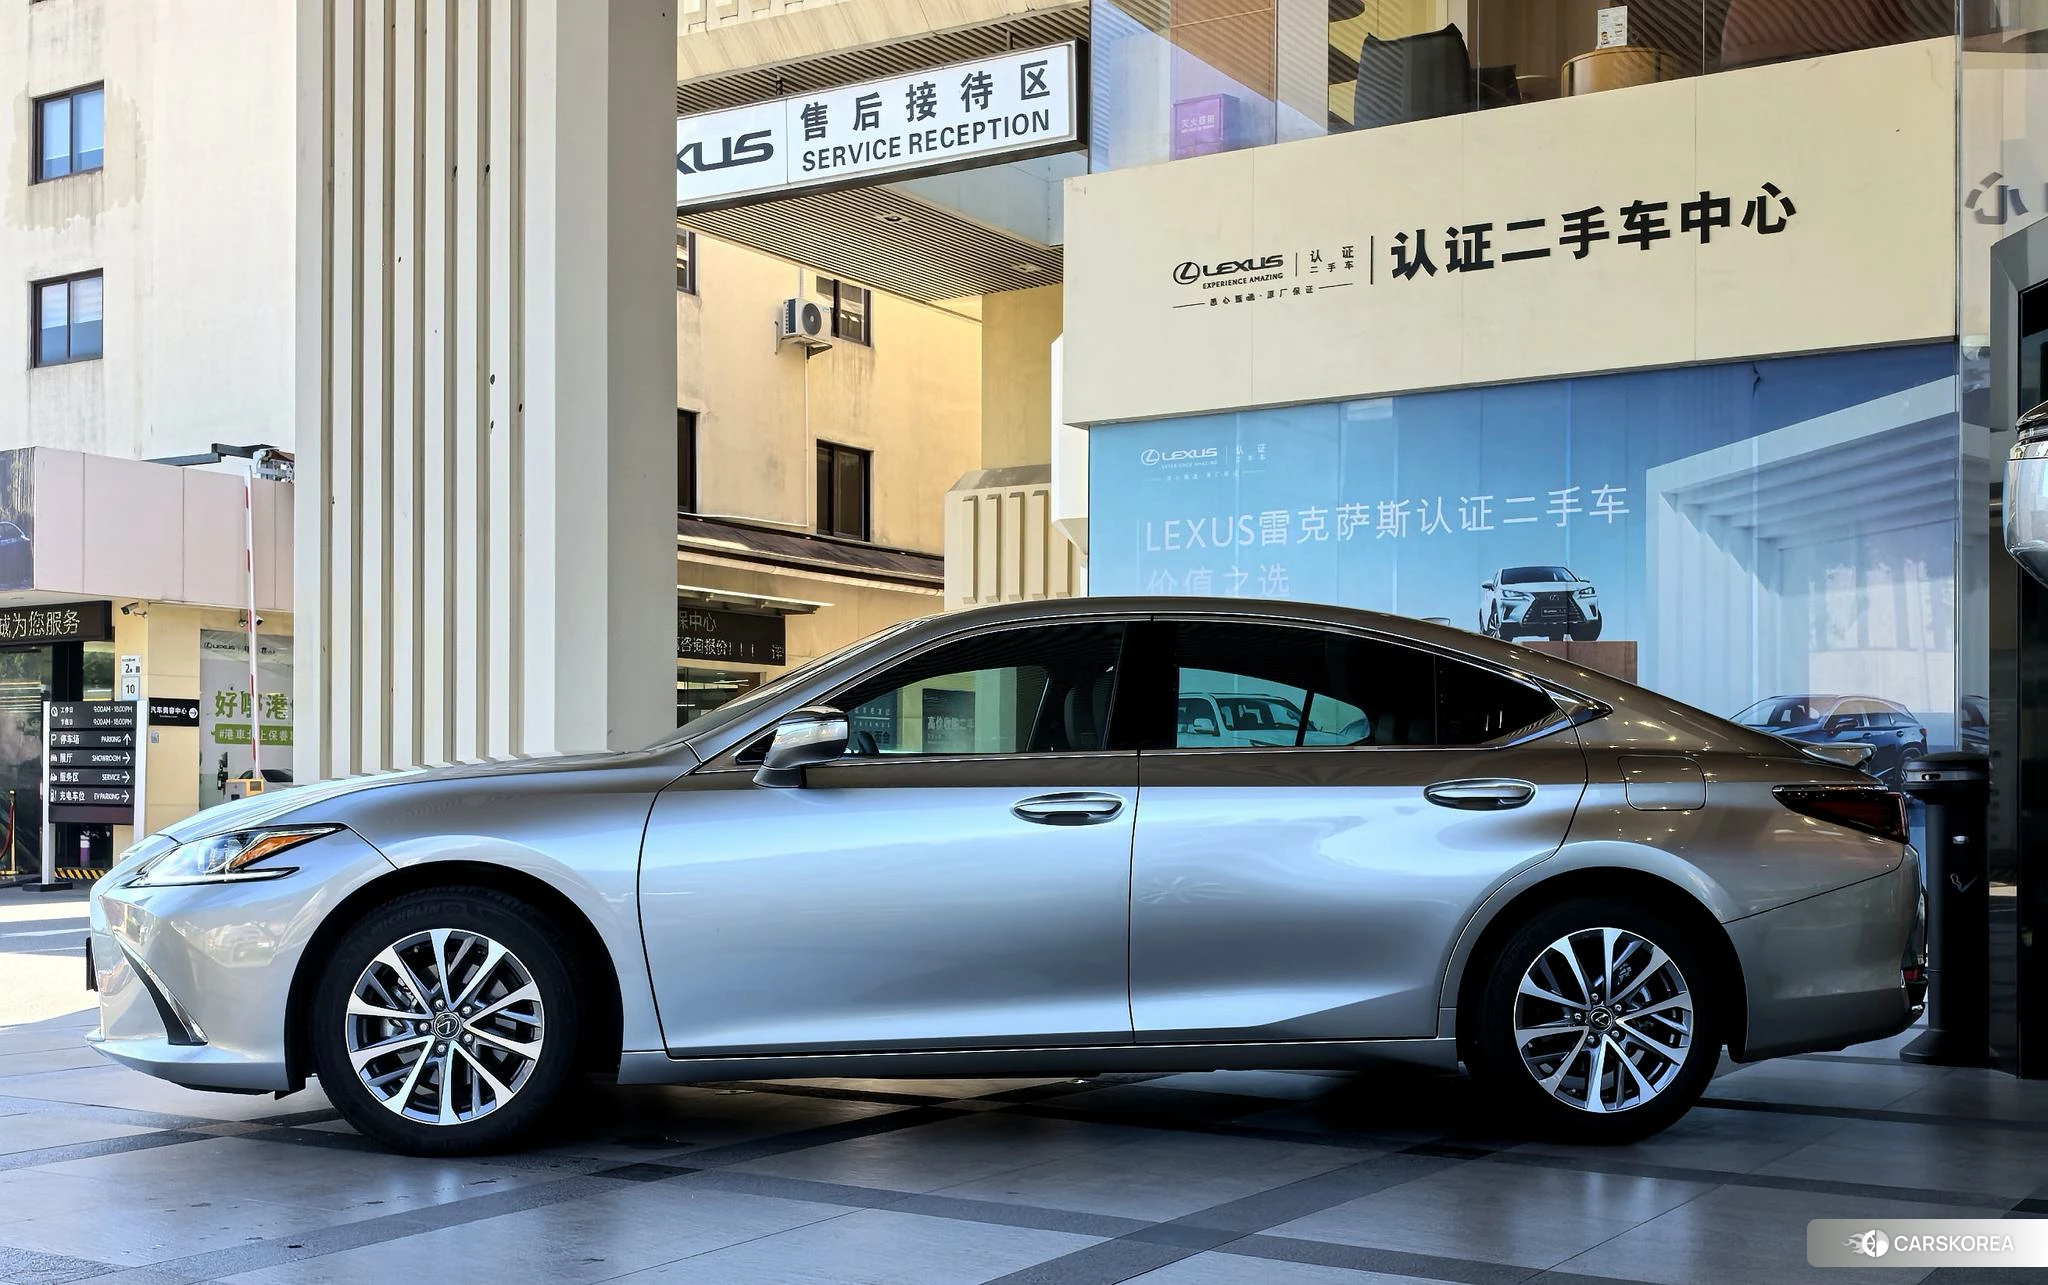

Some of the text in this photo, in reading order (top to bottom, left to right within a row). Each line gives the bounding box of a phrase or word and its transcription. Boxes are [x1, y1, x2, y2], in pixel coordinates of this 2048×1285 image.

[799, 60, 1050, 142] 售后接待区
[802, 108, 1050, 172] SERVICE RECEPTION
[1390, 181, 1798, 282] 认证二手车中心
[1309, 245, 1354, 263] 认证
[1202, 254, 1284, 277] LEXUS
[1309, 261, 1354, 274] 二手车
[1202, 272, 1284, 289] EXPERIENCE AMAZING
[1161, 447, 1218, 461] LEXUS
[1146, 483, 1630, 551] LEXUS雷克萨斯认证二手车
[1148, 563, 1291, 596] 价值之选
[125, 684, 136, 694] 10
[60, 734, 80, 745] 停车场
[100, 735, 121, 743] PARKING
[60, 752, 121, 764] 展厅 SHOWROOM
[59, 771, 120, 782] 服务区 SERVICE
[59, 790, 86, 801] 充电车位
